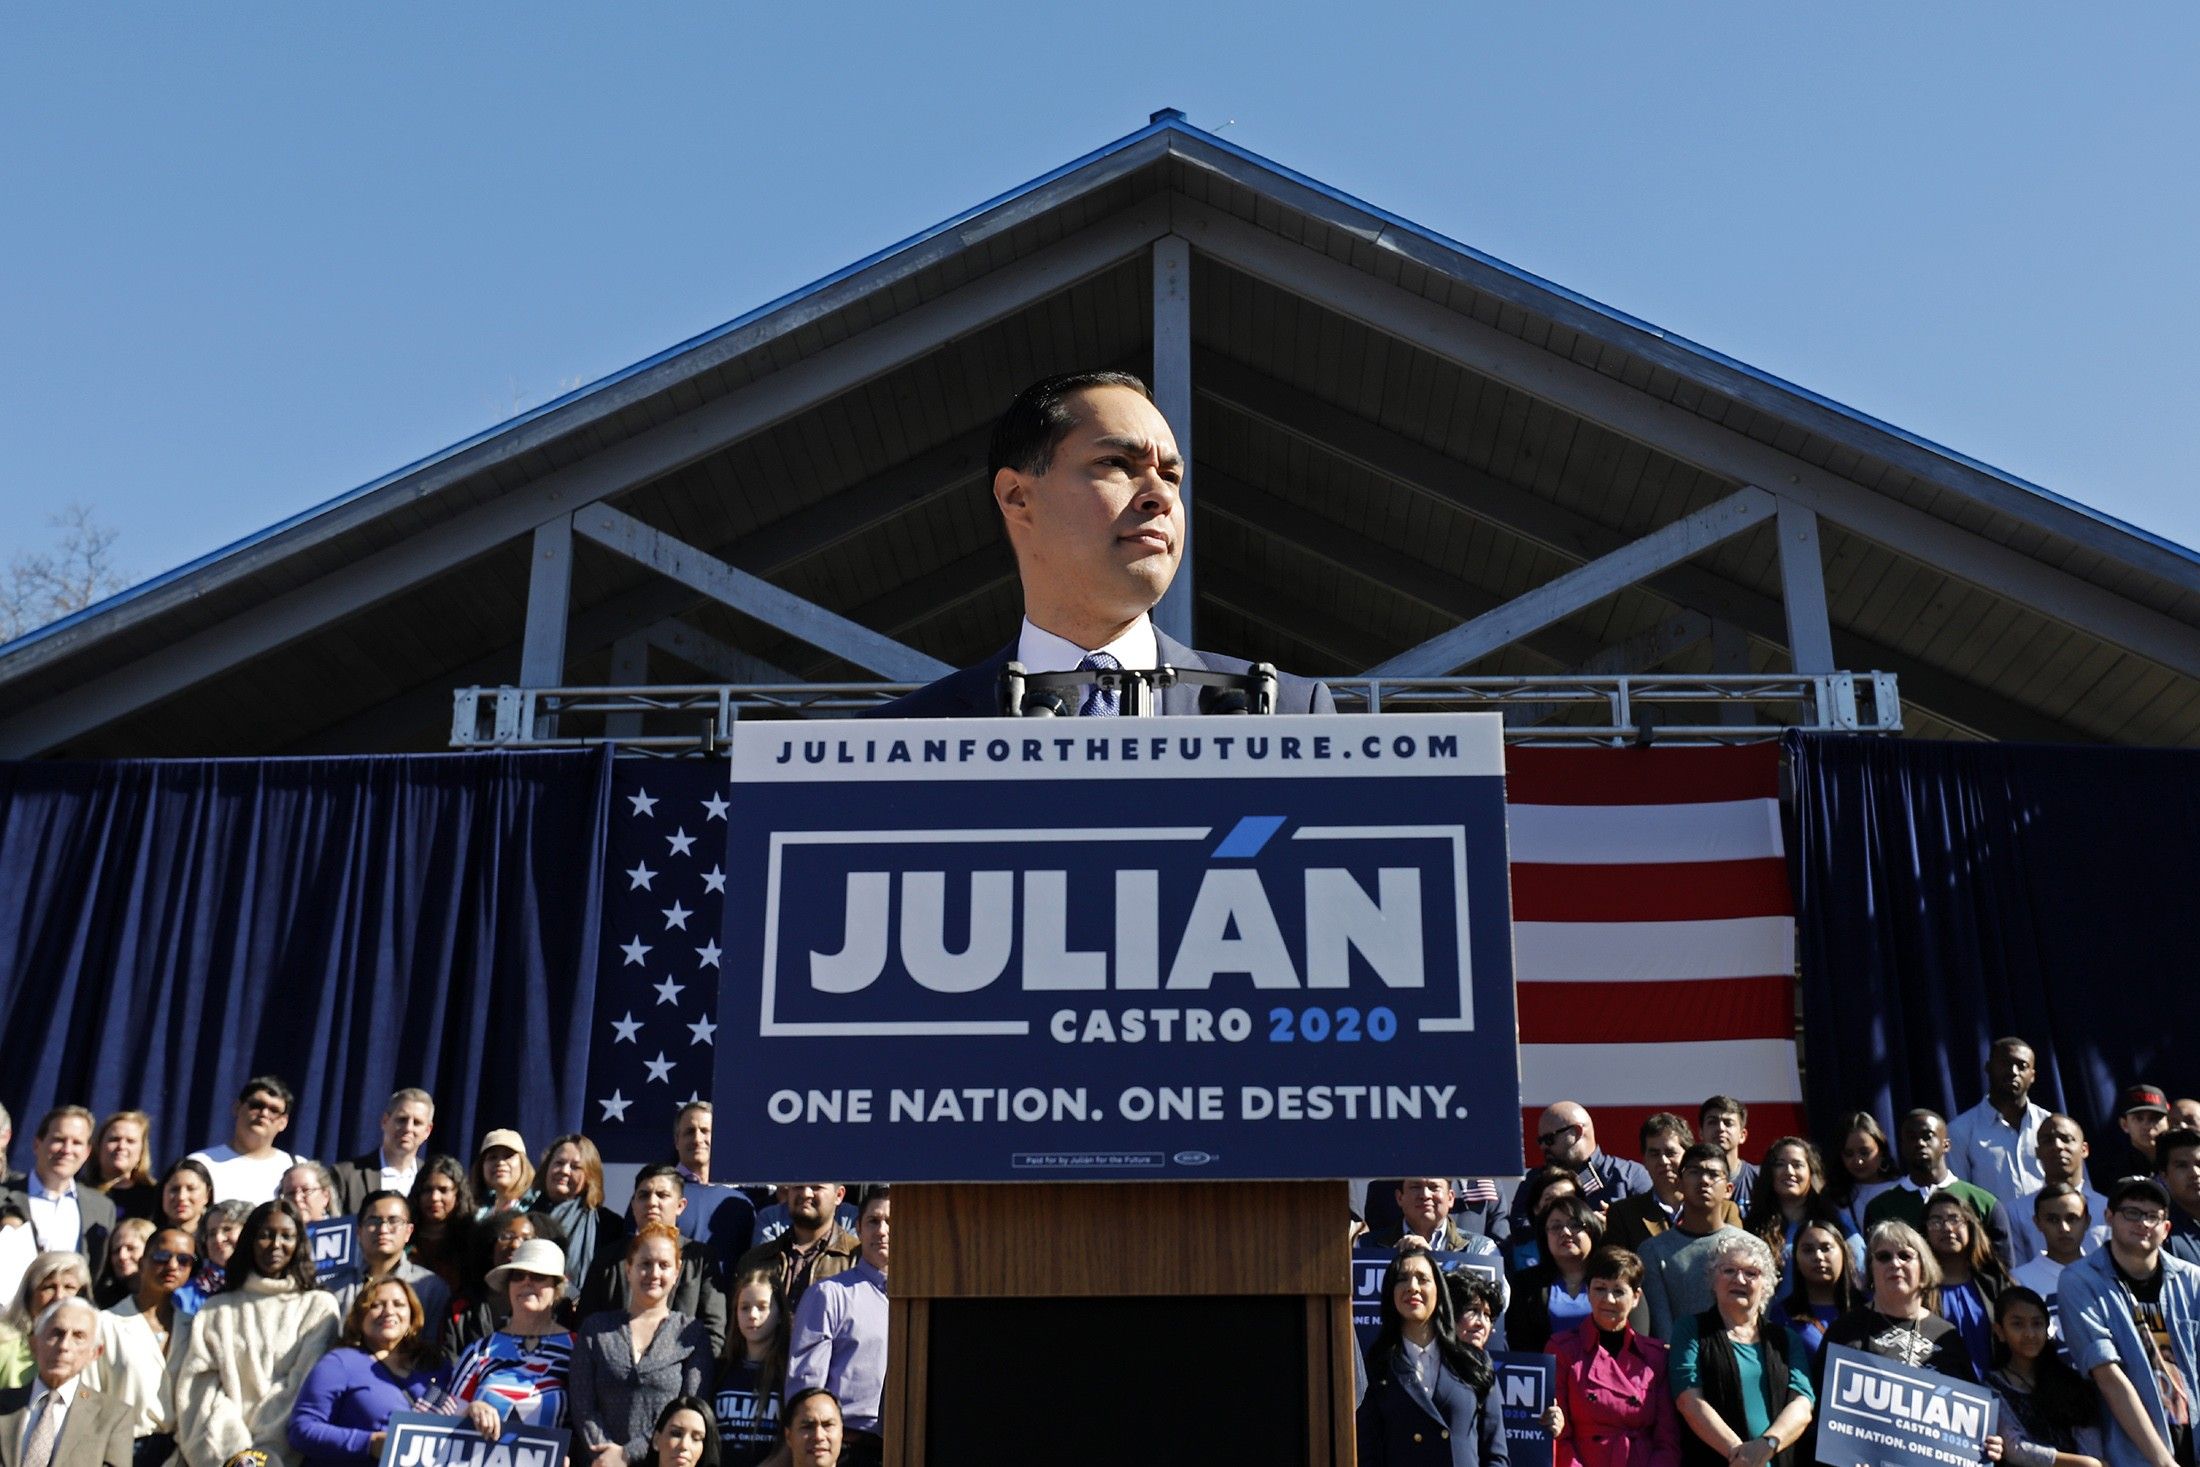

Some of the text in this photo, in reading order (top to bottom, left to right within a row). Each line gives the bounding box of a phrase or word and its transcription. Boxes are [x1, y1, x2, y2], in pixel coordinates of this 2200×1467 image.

[776, 735, 1460, 764] JULIANFORTHEFUTURE.COM
[809, 815, 1425, 994] JULIÁN
[1049, 1006, 1398, 1044] CASTRO 2020
[767, 1084, 1468, 1124] ONE NATION. ONE DESTINY.
[1026, 1156, 1043, 1164] Paid
[1045, 1156, 1057, 1164] for
[1109, 1155, 1123, 1163] the
[1125, 1155, 1150, 1163] Future
[1842, 1372, 1980, 1439] JULIÁN
[1828, 1420, 1854, 1436] ONE
[1855, 1426, 1907, 1451] NATION.
[1908, 1441, 1933, 1459] ONE
[1895, 1418, 1970, 1449] CASTRO 2020
